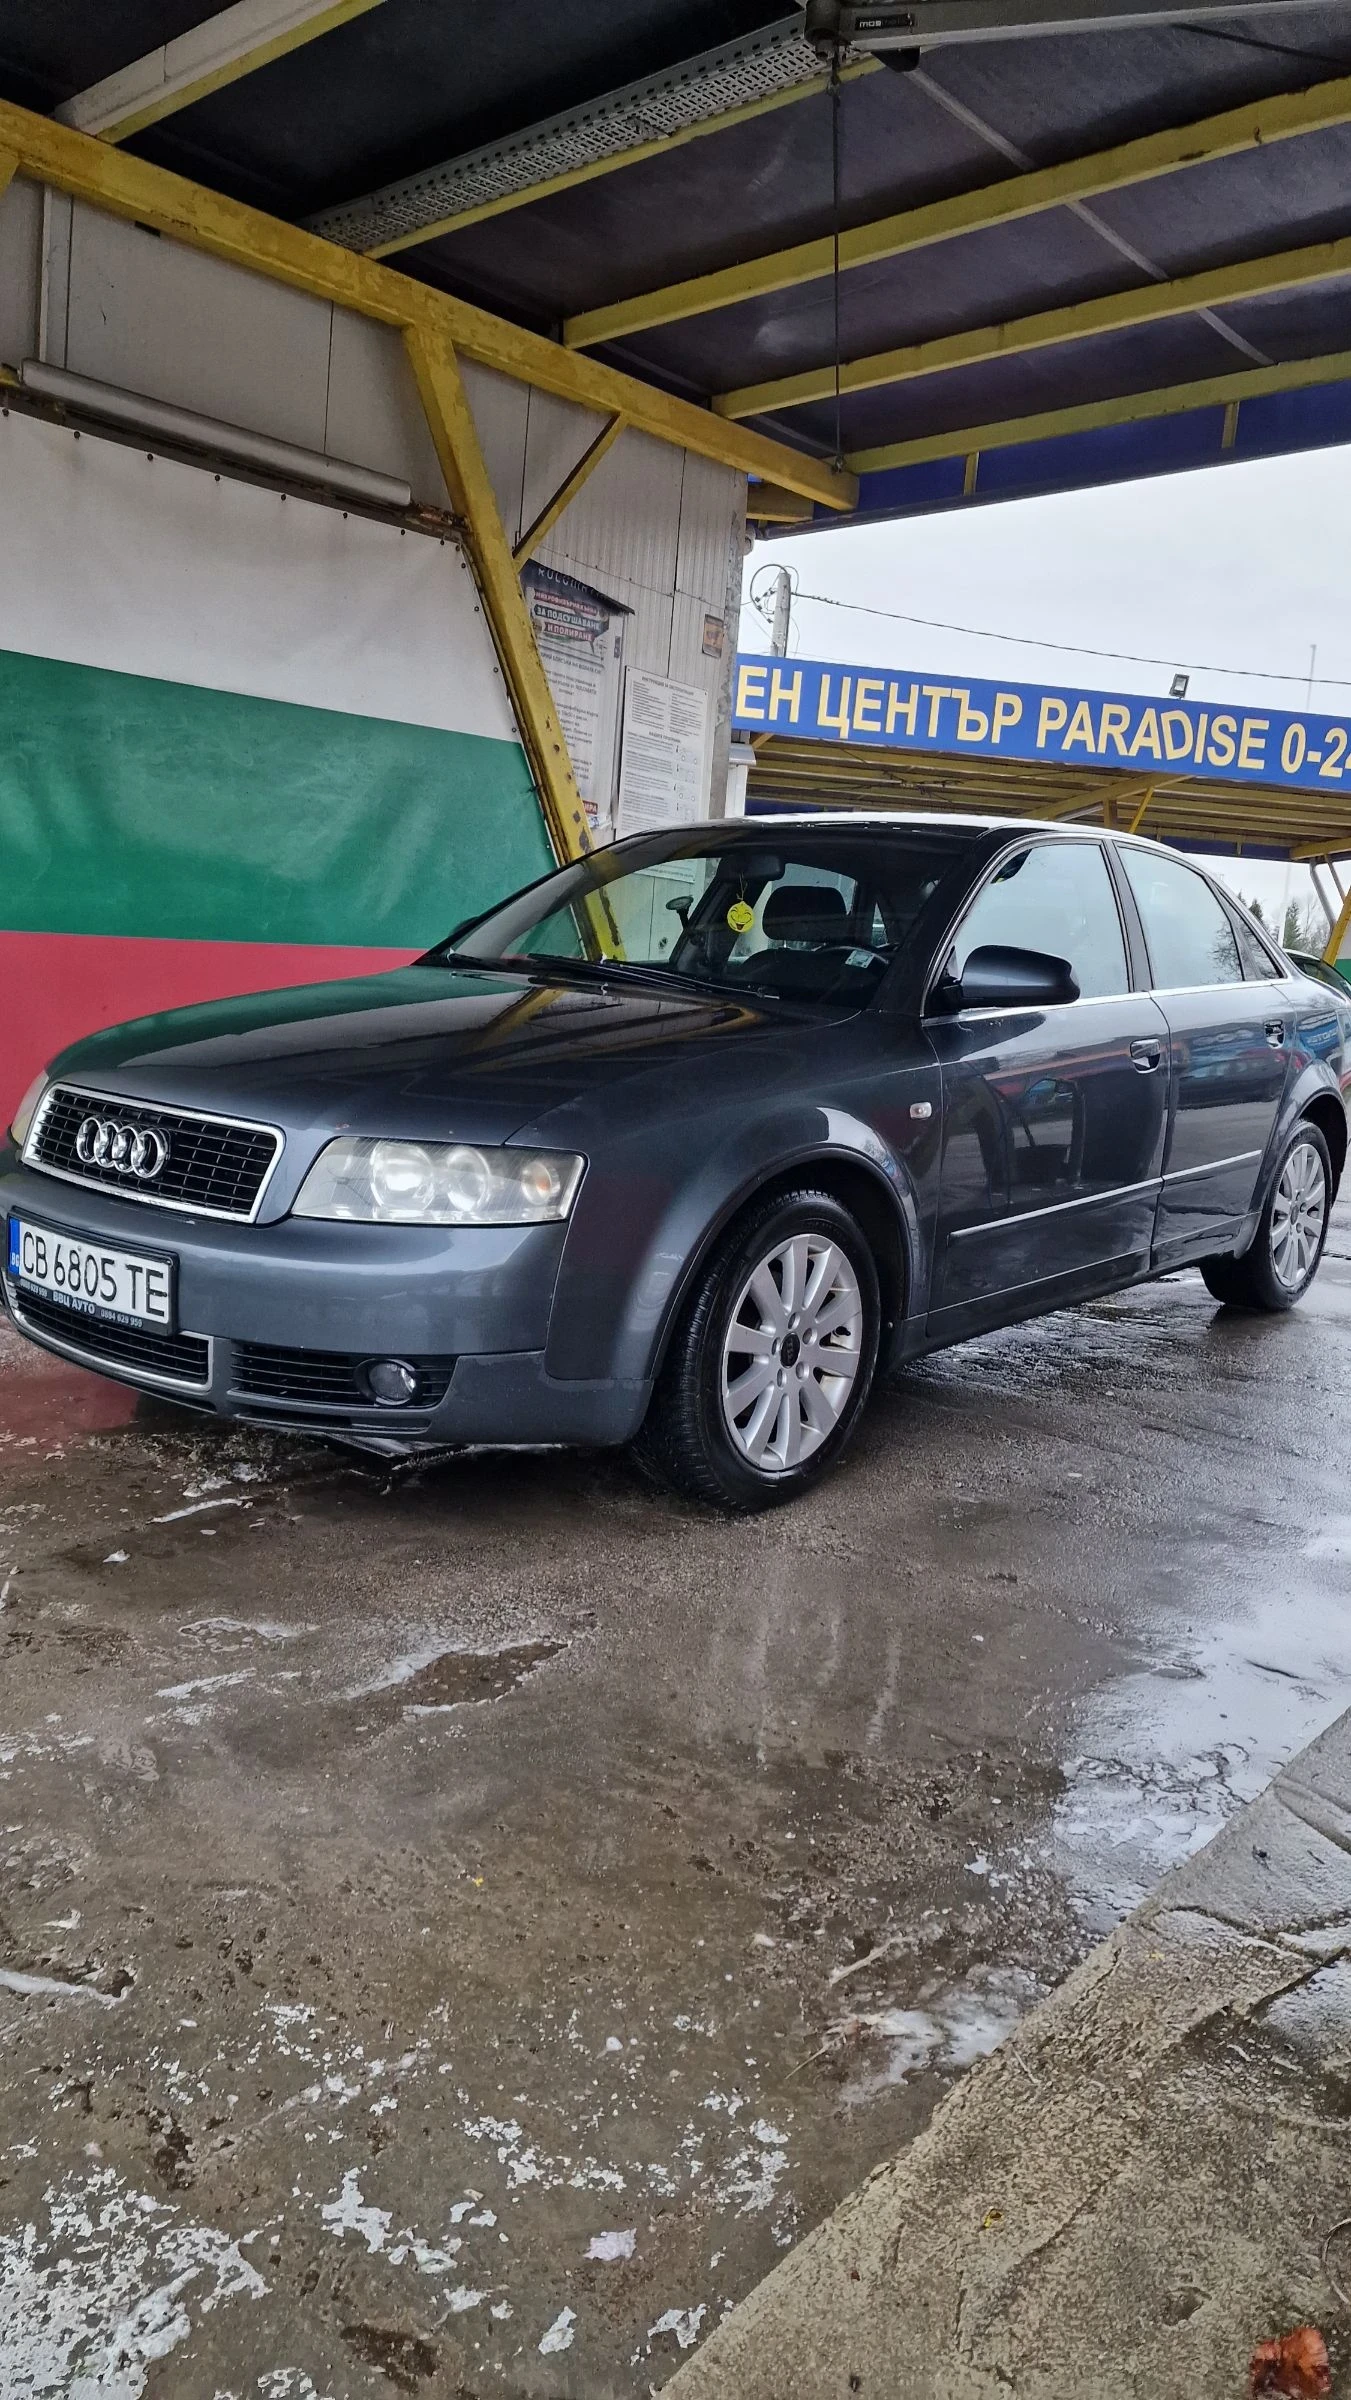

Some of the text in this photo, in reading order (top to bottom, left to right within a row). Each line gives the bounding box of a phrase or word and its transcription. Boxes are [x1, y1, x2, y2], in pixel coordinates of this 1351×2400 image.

[537, 606, 601, 631] ЗА ПОДСУШАВАНЕ
[554, 624, 593, 642] ПОЛИРАНЕ
[816, 673, 1023, 744] ЦЕНТЪР
[1036, 697, 1270, 770] PARADISE
[1281, 722, 1351, 778] 0-2
[11, 1252, 20, 1268] BG
[71, 1297, 96, 1315] АУТО
